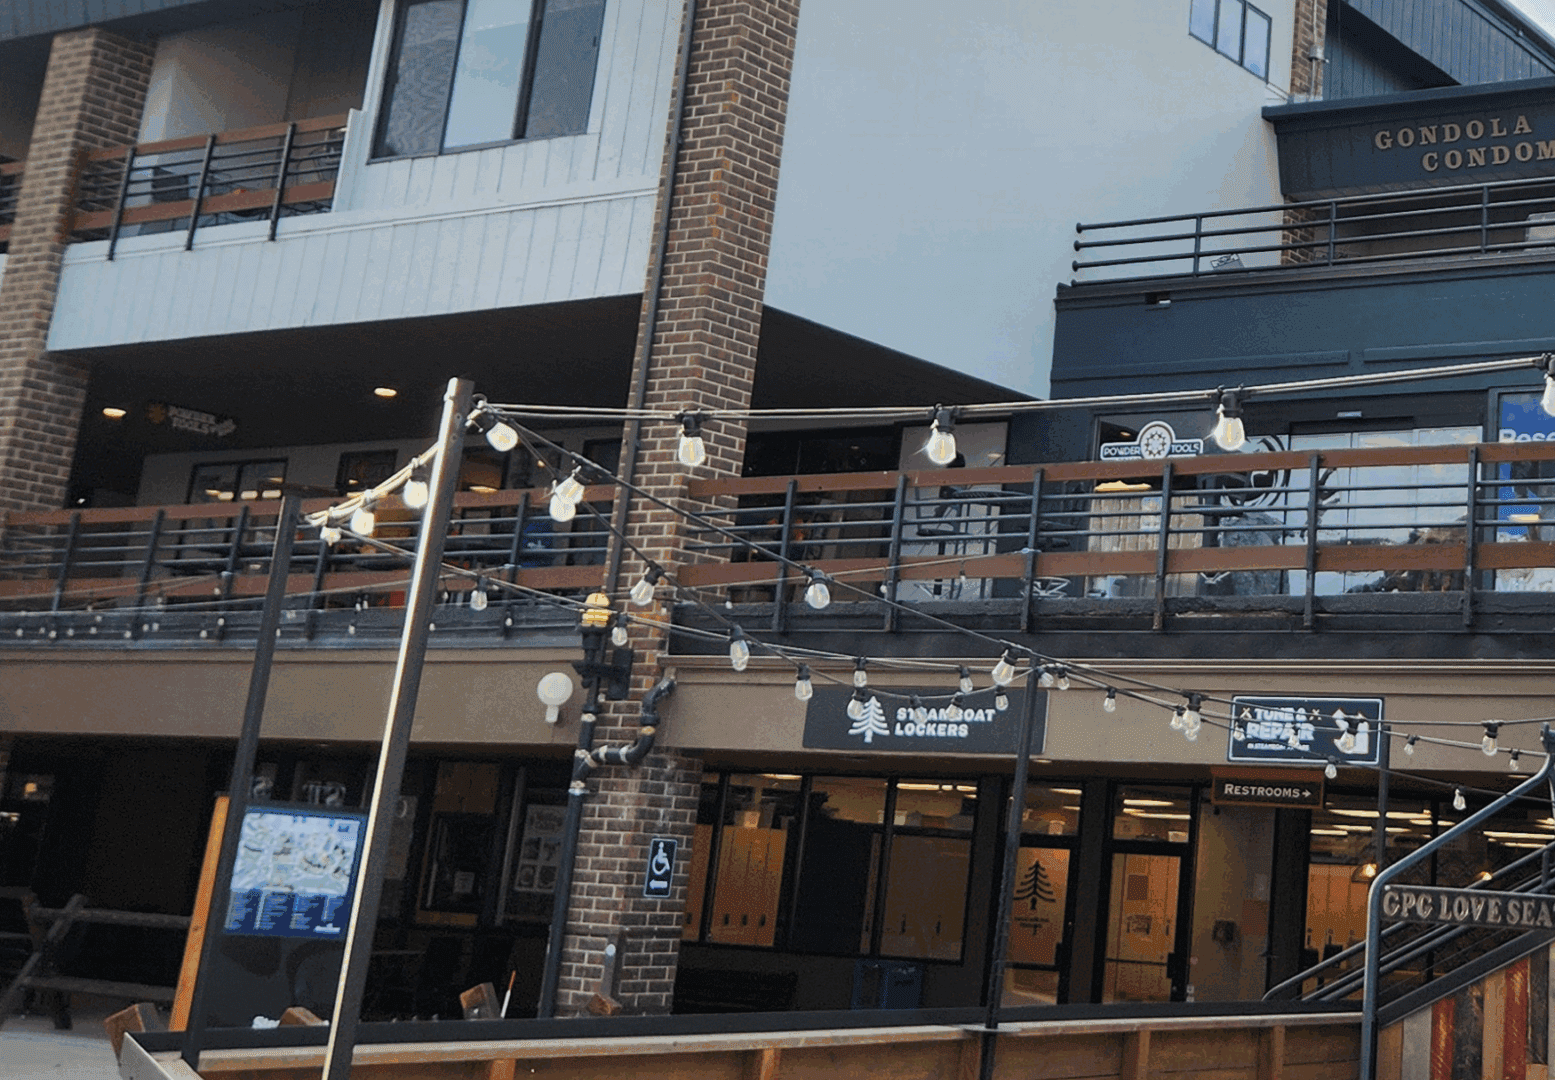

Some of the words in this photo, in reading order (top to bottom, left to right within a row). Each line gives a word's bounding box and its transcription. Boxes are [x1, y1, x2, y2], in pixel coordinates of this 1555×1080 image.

[1374, 115, 1532, 151] GONDOLA
[1103, 445, 1141, 456] POWDER
[1171, 442, 1199, 453] TOOLS
[896, 706, 996, 722] STAMOAT
[1254, 707, 1295, 722] TUNE
[895, 722, 969, 738] LOCKERS
[1224, 783, 1301, 798] RESTROOMS
[1438, 894, 1503, 924] LOVE
